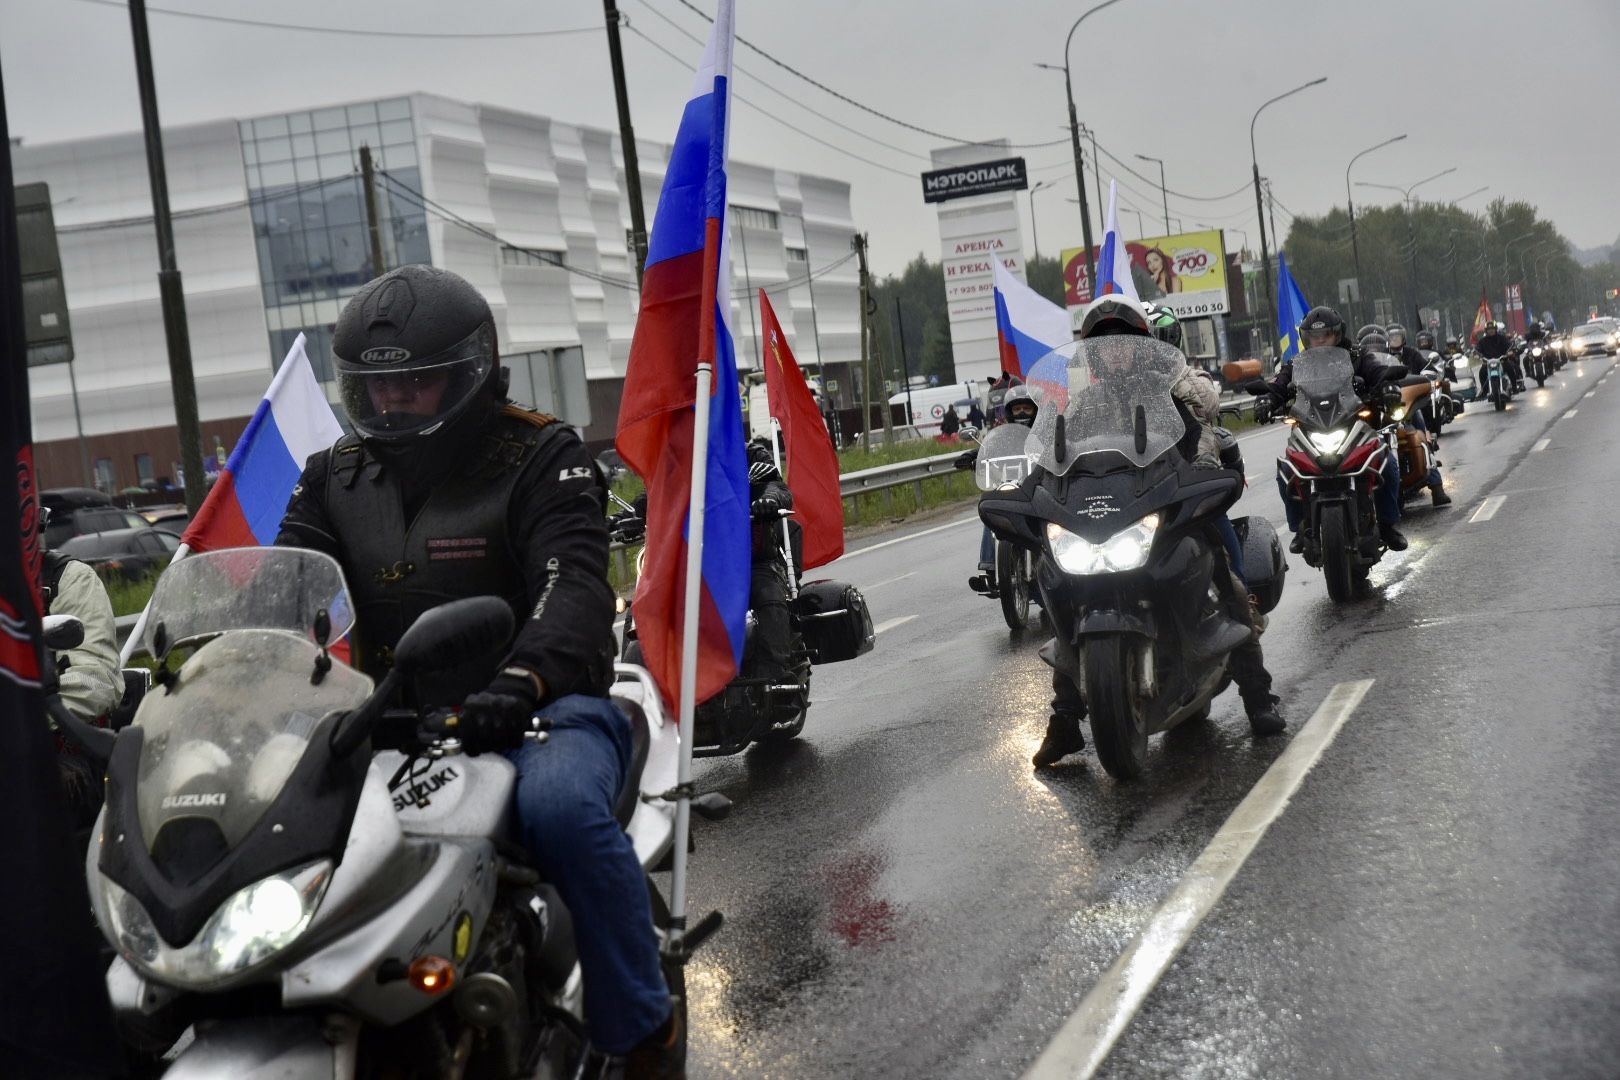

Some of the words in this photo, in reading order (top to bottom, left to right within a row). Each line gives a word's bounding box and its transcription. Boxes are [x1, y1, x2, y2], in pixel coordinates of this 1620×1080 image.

[927, 163, 1017, 191] МЭТРОПАРК
[955, 239, 1004, 254] АРЕНДА
[947, 265, 956, 276] И
[960, 258, 1016, 274] РЕКЛА
[1178, 254, 1207, 272] 700
[1175, 305, 1193, 316] 153
[1195, 304, 1208, 313] 00
[1211, 302, 1223, 311] 30
[559, 467, 593, 481] LS2
[161, 792, 227, 809] SUZUKI
